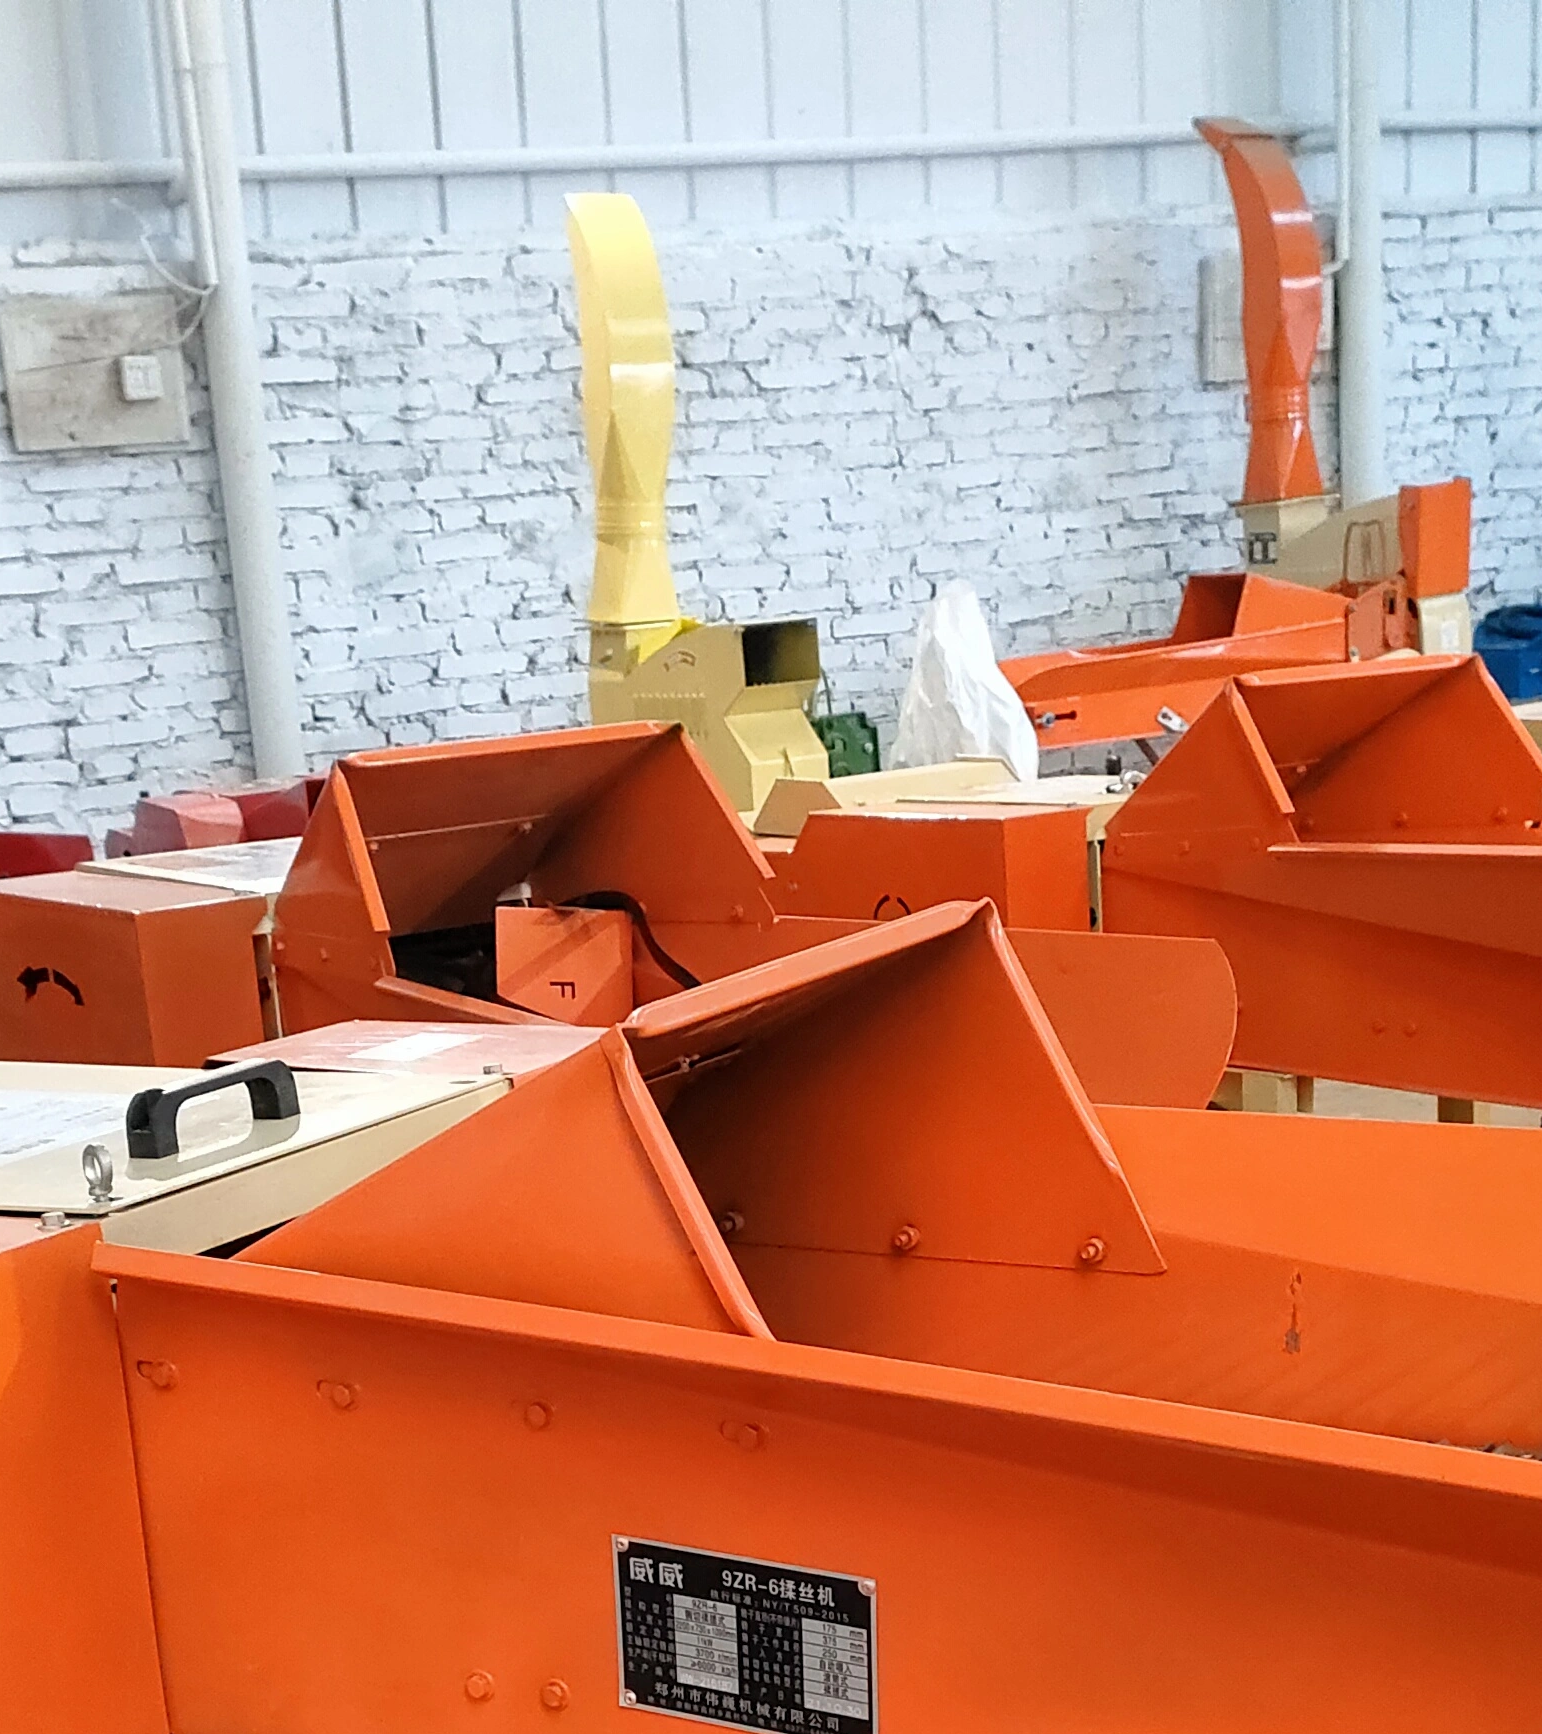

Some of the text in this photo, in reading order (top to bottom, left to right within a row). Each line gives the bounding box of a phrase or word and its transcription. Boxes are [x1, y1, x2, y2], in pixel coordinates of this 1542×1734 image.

[722, 1568, 835, 1607] 9ZR-6揉丝机
[793, 1605, 849, 1623] 509-2015
[823, 1625, 836, 1634] 175
[823, 1637, 837, 1647] 375
[822, 1649, 837, 1659] 250
